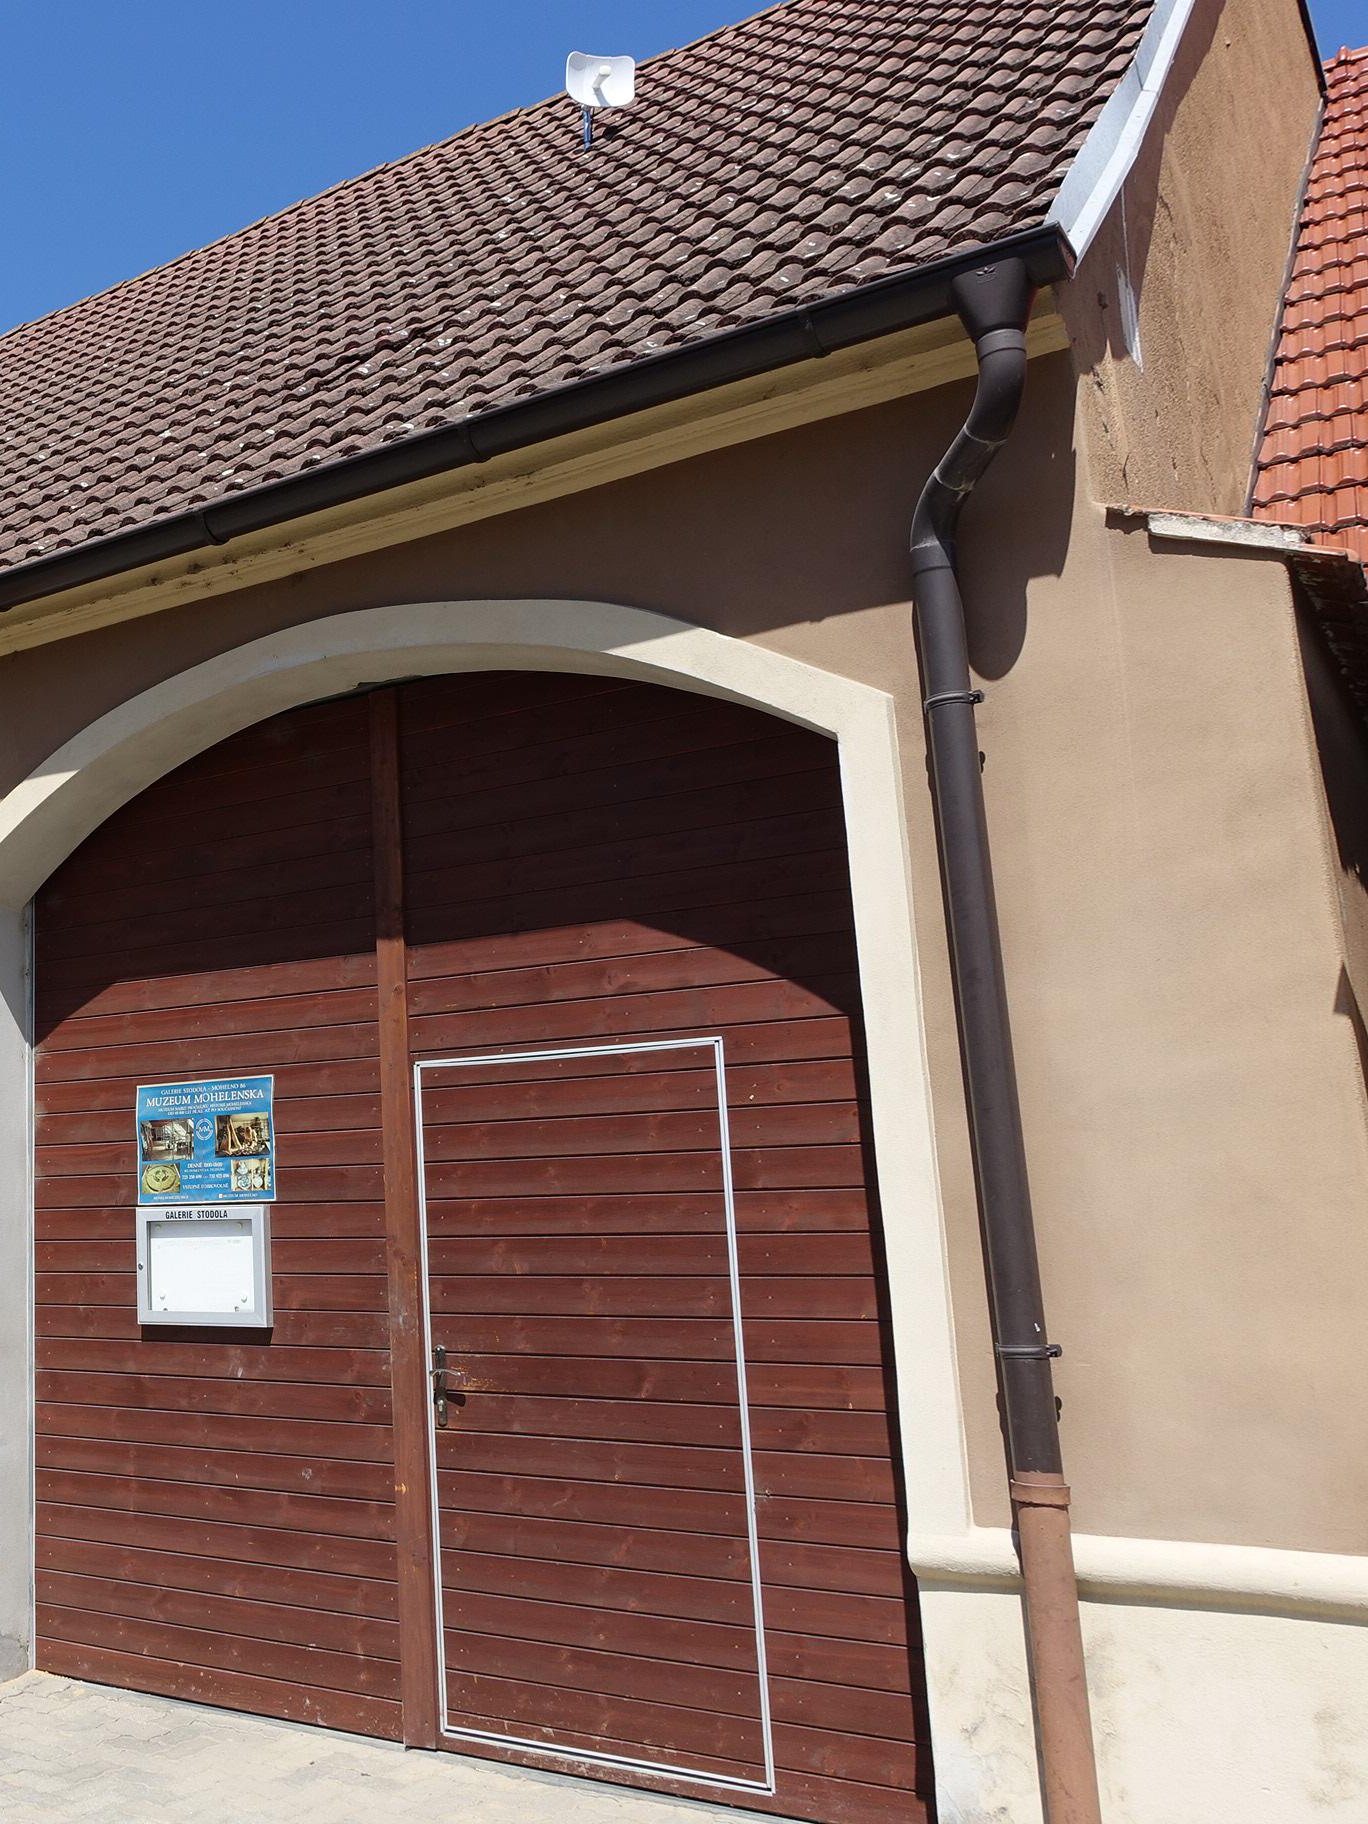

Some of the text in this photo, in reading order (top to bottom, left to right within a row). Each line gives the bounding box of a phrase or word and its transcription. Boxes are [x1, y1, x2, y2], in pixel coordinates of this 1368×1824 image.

[161, 1088, 183, 1096] GALERIE
[183, 1085, 207, 1094] STODOLA
[211, 1083, 239, 1092] MOHELNO
[146, 1089, 264, 1107] MUZEUM MOHELENSKA
[165, 1209, 228, 1219] GALERIE STODOLA
